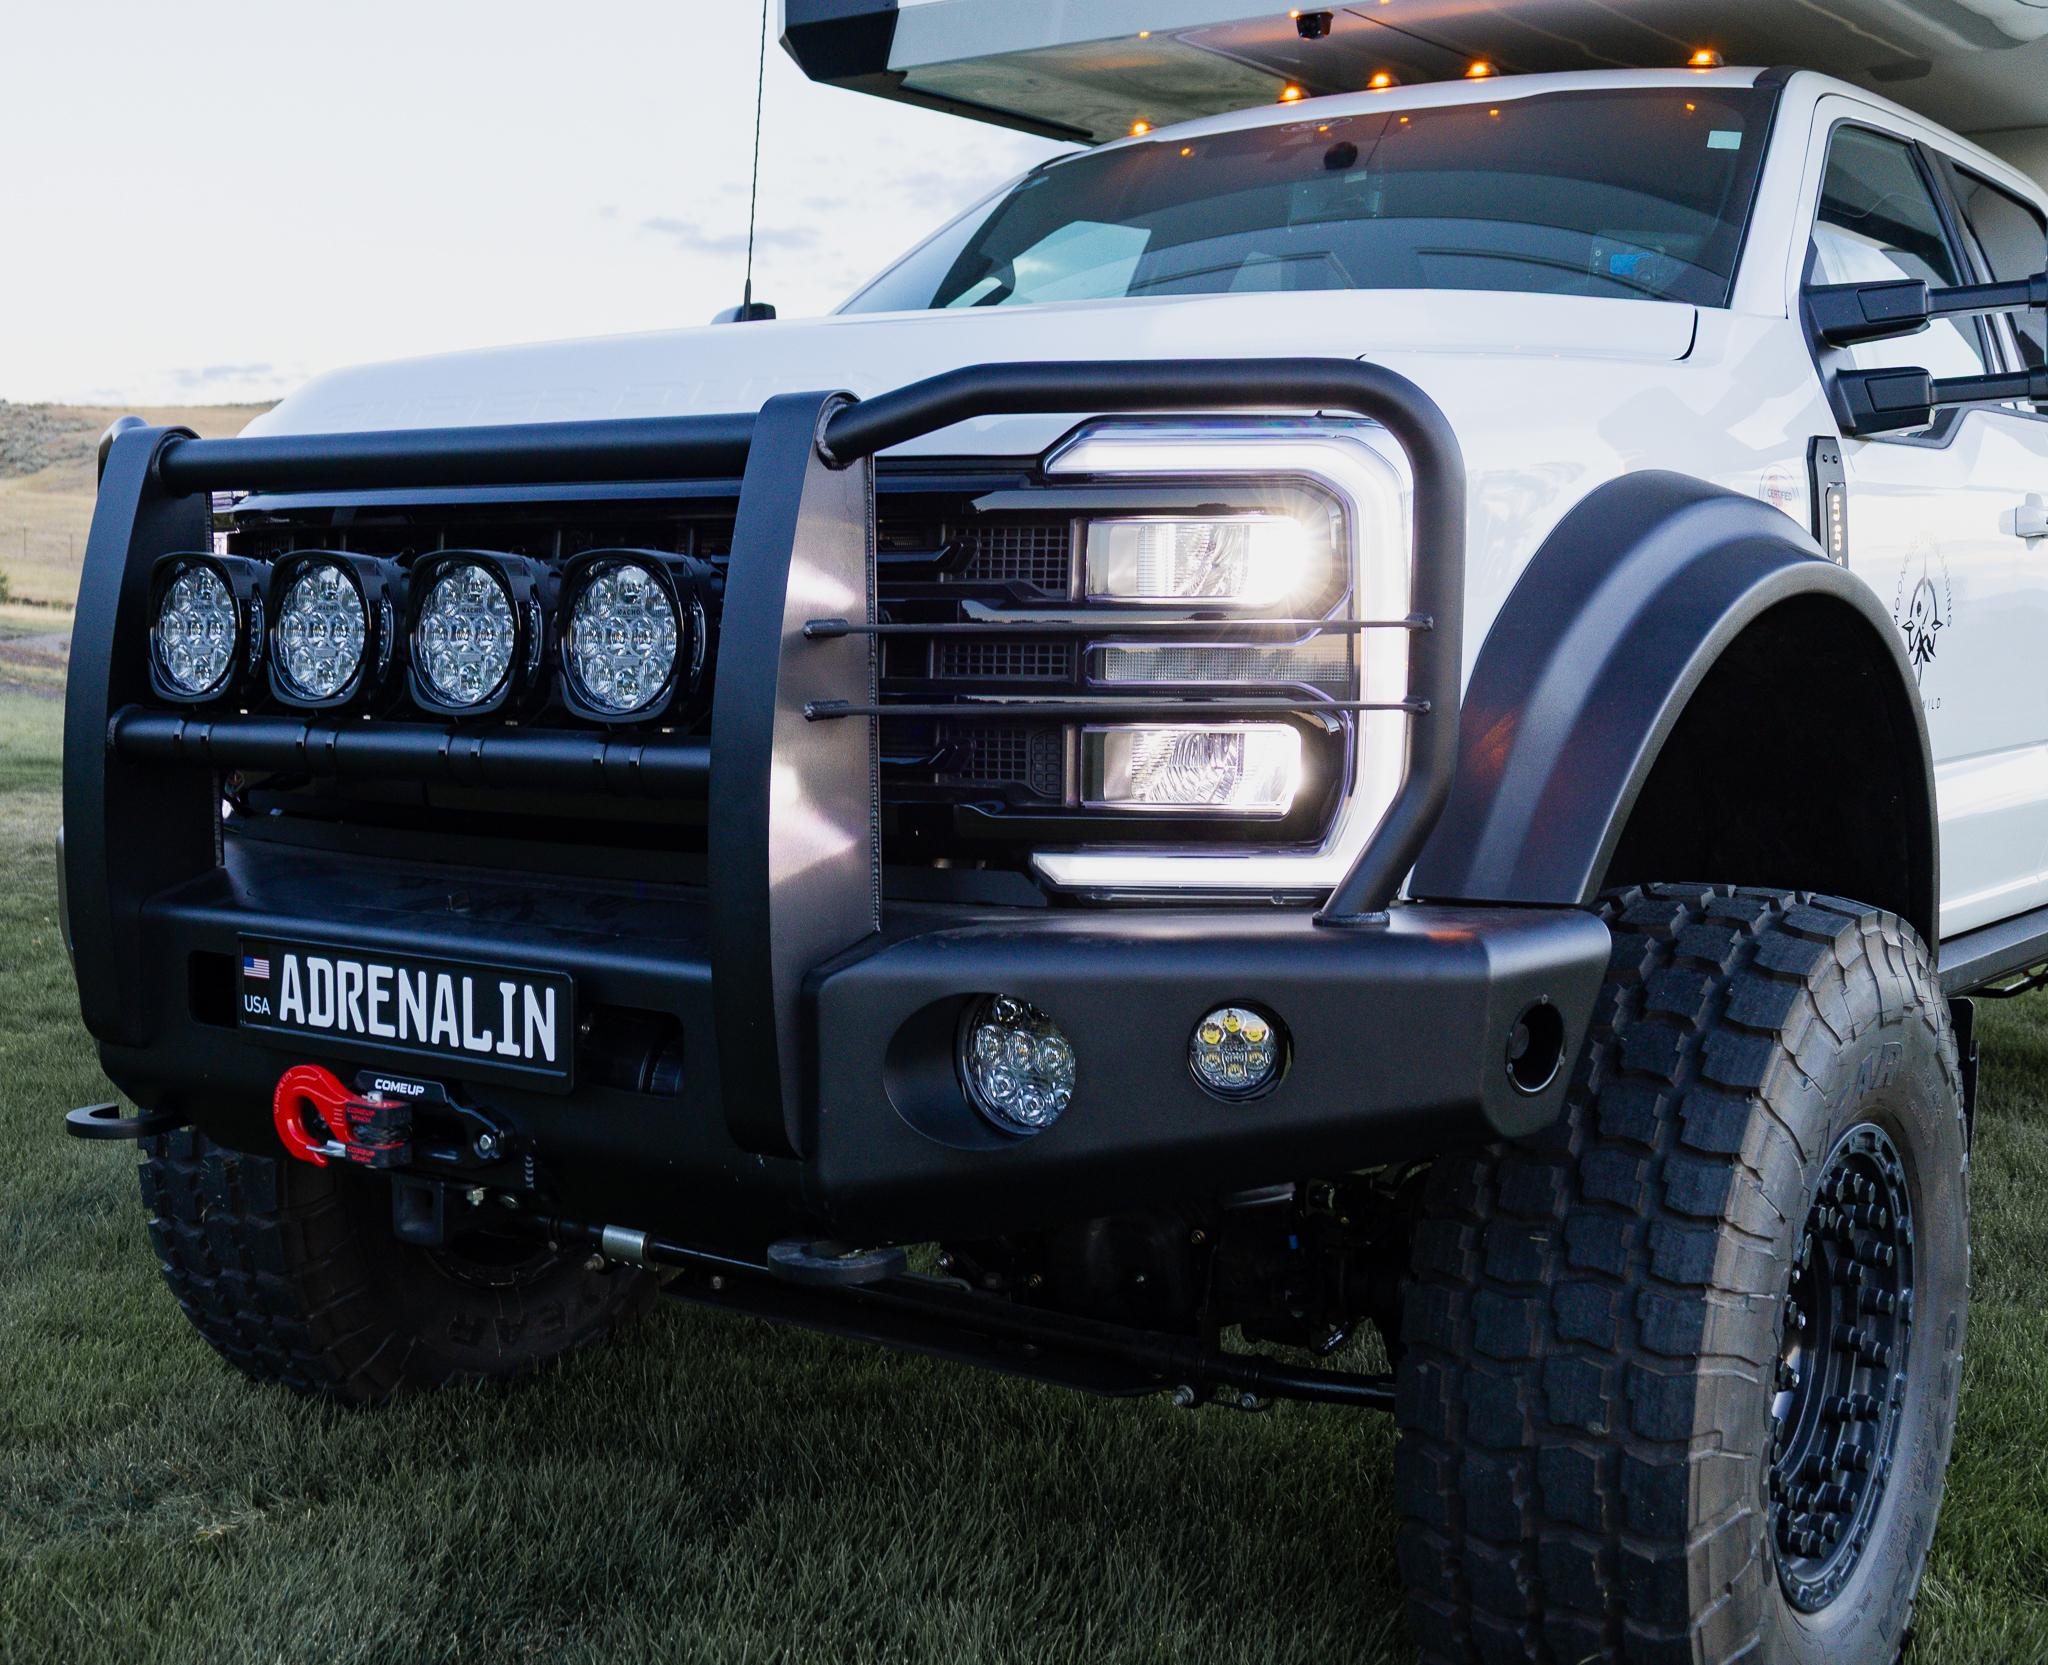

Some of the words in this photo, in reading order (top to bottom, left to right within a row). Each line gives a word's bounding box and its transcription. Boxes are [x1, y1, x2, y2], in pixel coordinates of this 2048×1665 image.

[244, 994, 271, 1016] USA
[279, 954, 556, 1062] ADRENALIN
[374, 1078, 425, 1097] COMEUP
